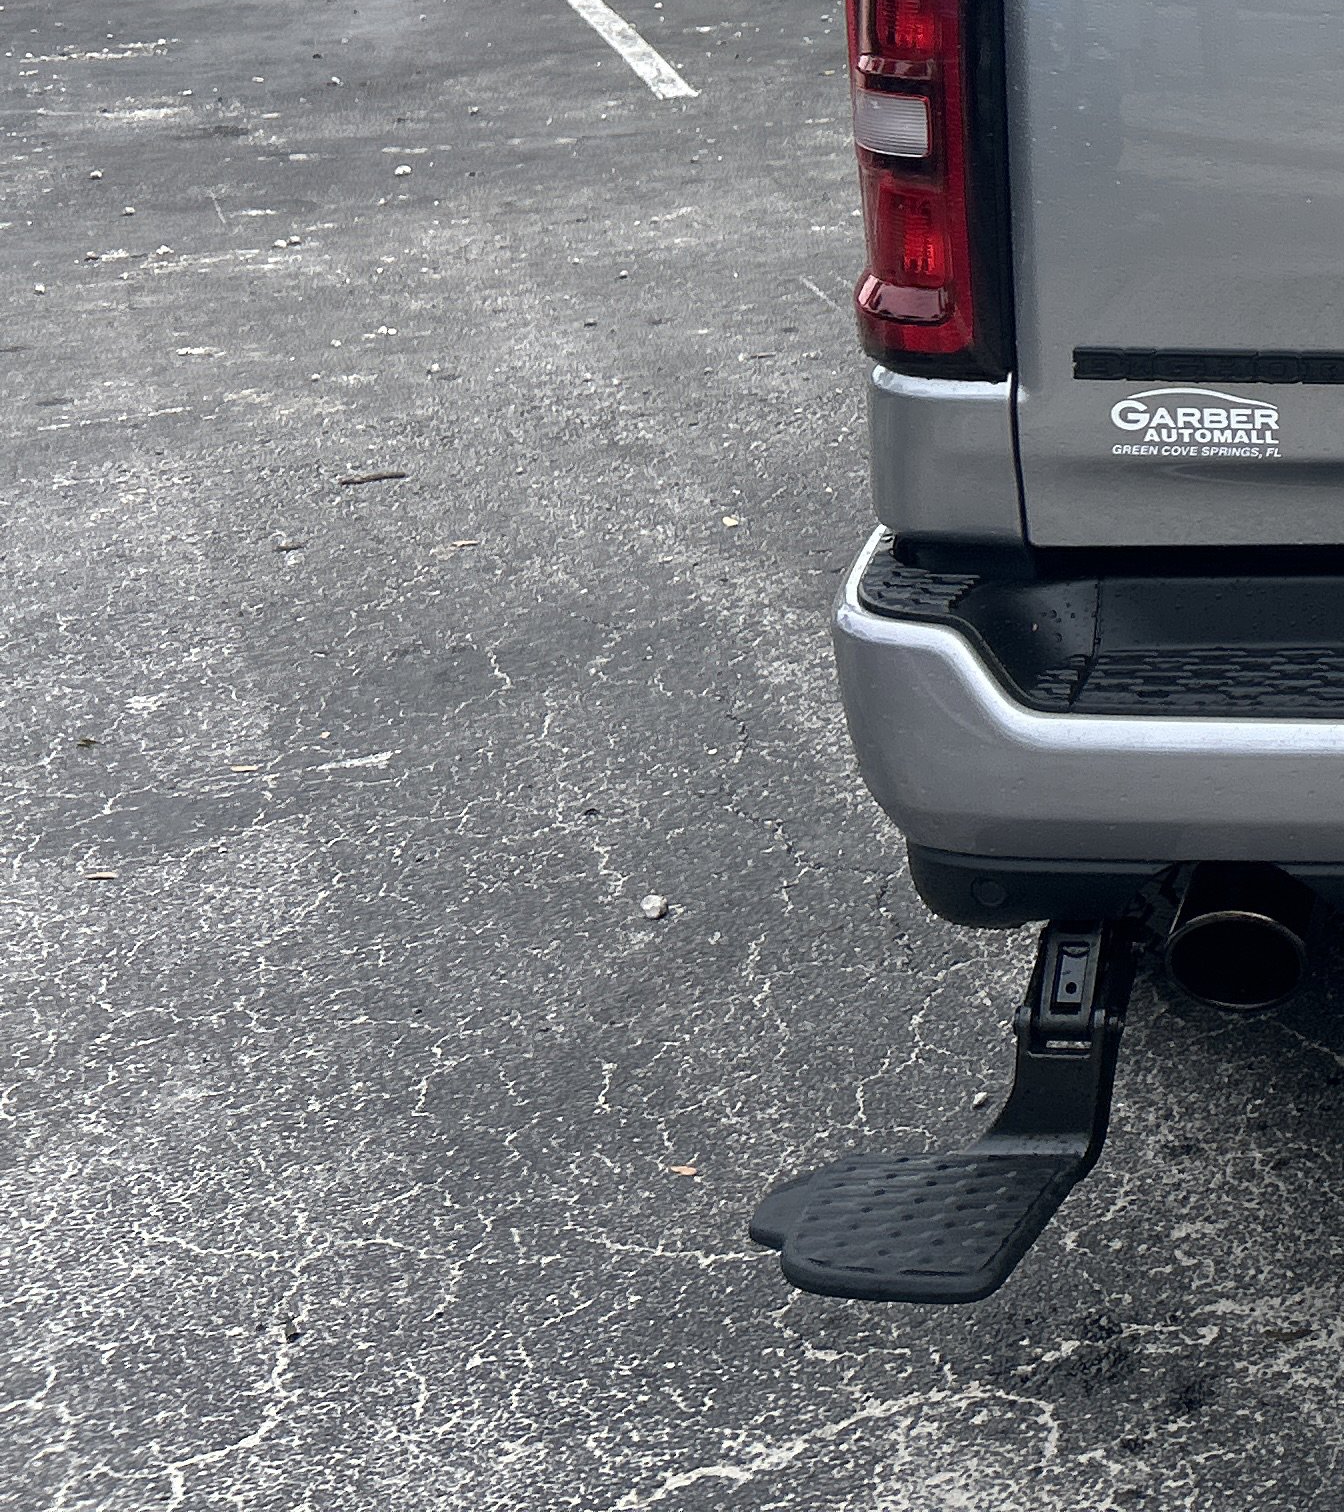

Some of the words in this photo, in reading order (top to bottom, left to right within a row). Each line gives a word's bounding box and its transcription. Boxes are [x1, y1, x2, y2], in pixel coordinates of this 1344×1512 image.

[1111, 399, 1280, 431] GARBER
[1143, 428, 1280, 444] AUTOMALL
[1112, 444, 1158, 456] GREEN
[1161, 445, 1199, 457] COVE
[1201, 446, 1263, 459] SPRINGS,
[1265, 447, 1282, 458] FL
